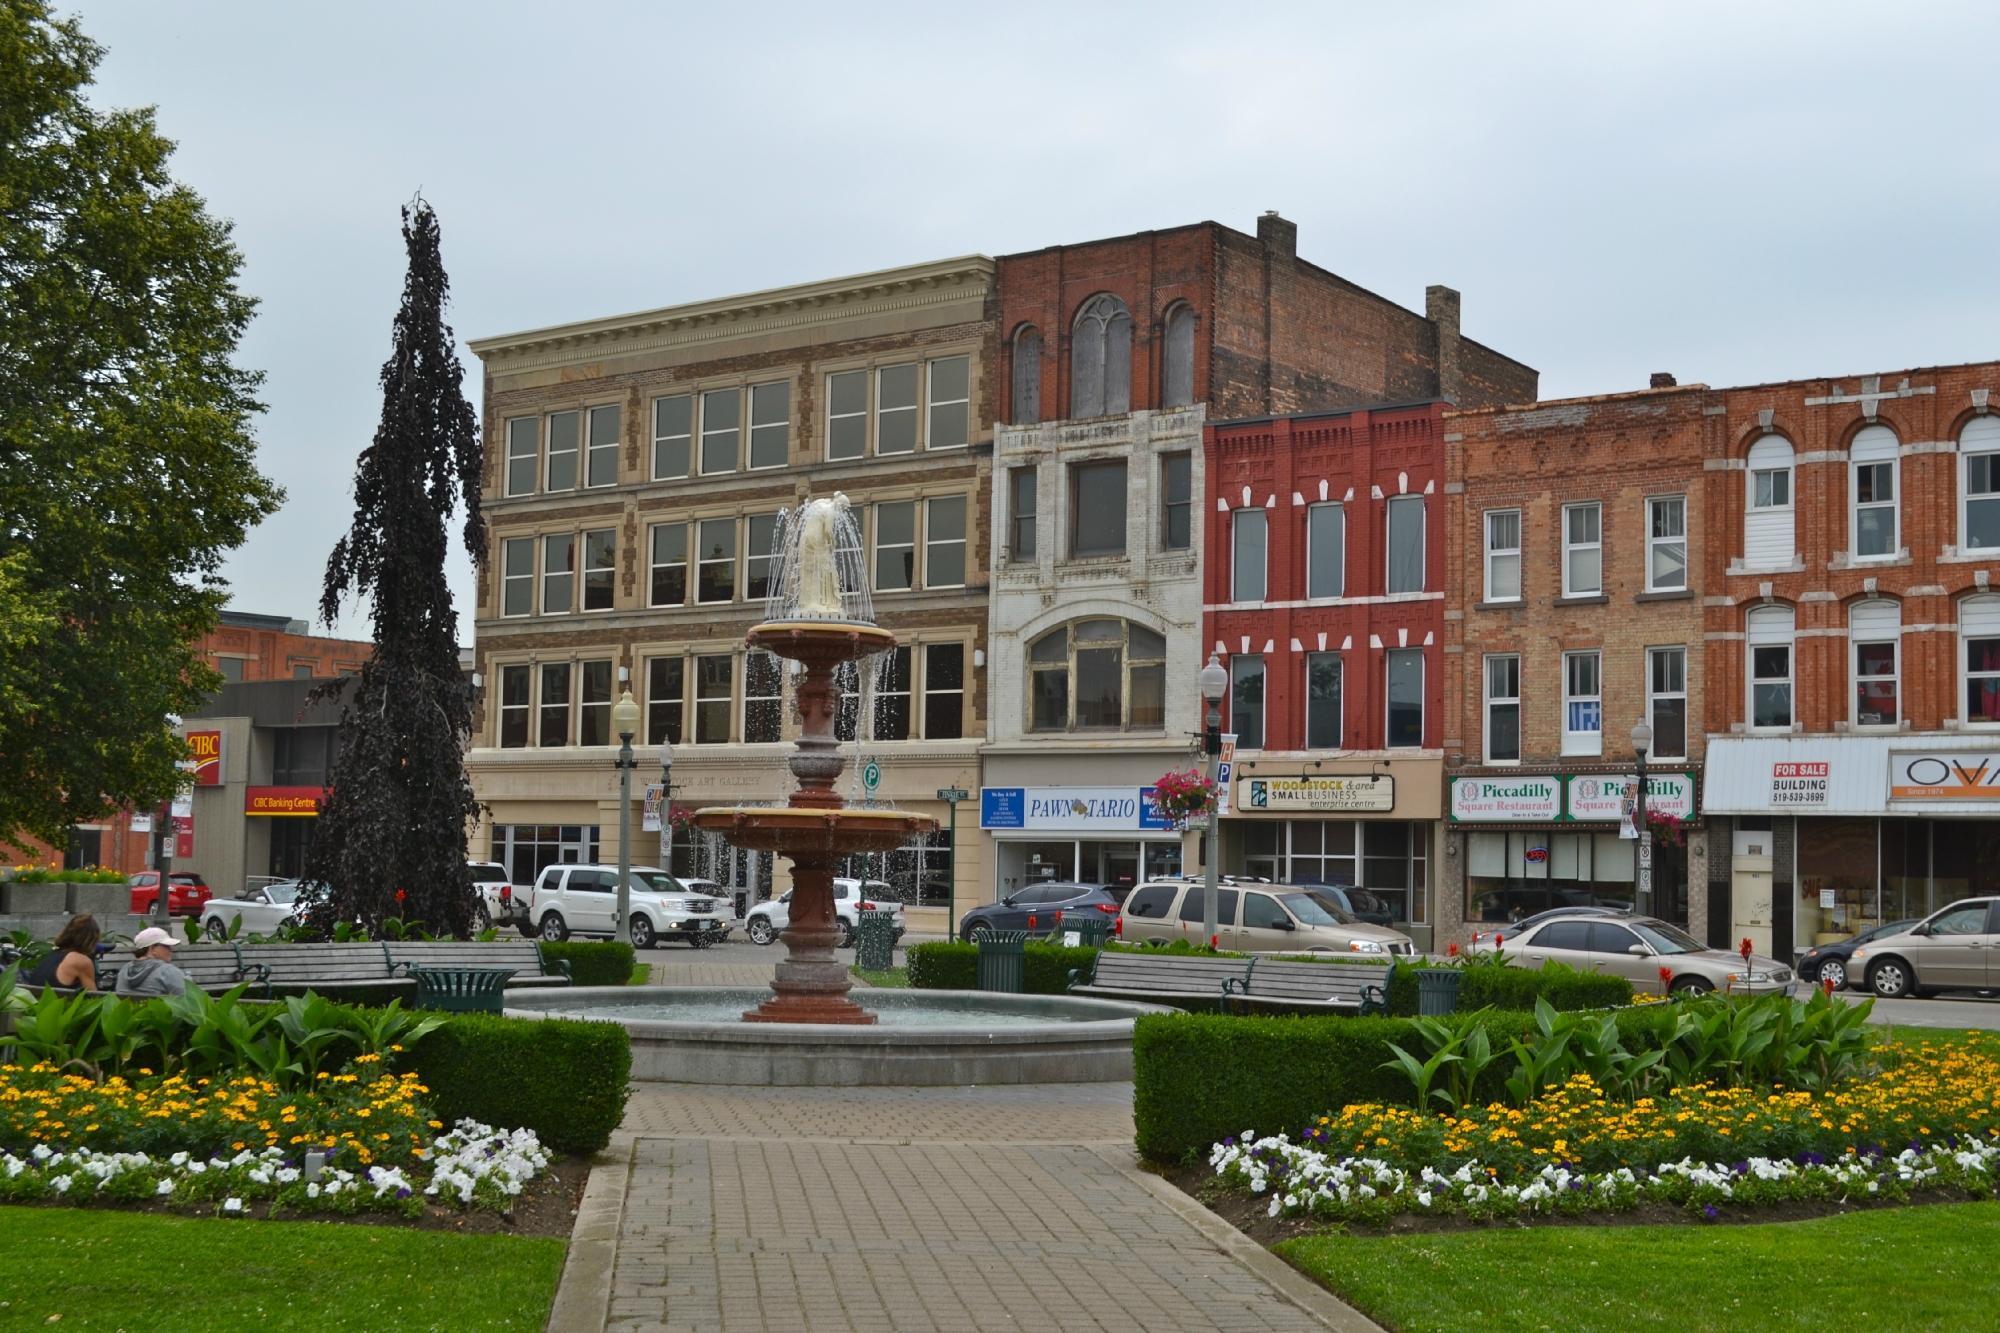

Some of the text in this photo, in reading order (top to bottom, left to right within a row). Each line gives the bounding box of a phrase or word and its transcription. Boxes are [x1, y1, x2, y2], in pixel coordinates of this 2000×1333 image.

[1775, 763, 1827, 776] FOR SALE
[697, 777, 716, 786] ART
[868, 769, 877, 783] P
[1271, 781, 1343, 791] WOODSTOCK
[1355, 782, 1375, 790] area
[1773, 780, 1826, 790] BUILDING
[1482, 784, 1553, 801] Piccadilly
[254, 798, 315, 810] CIBC Banking Centre
[1030, 800, 1073, 817] PAWN
[1087, 800, 1135, 818] TARIO
[1310, 800, 1349, 809] enterprise
[1458, 801, 1553, 813] Square Restaurant
[1575, 800, 1616, 811] Square
